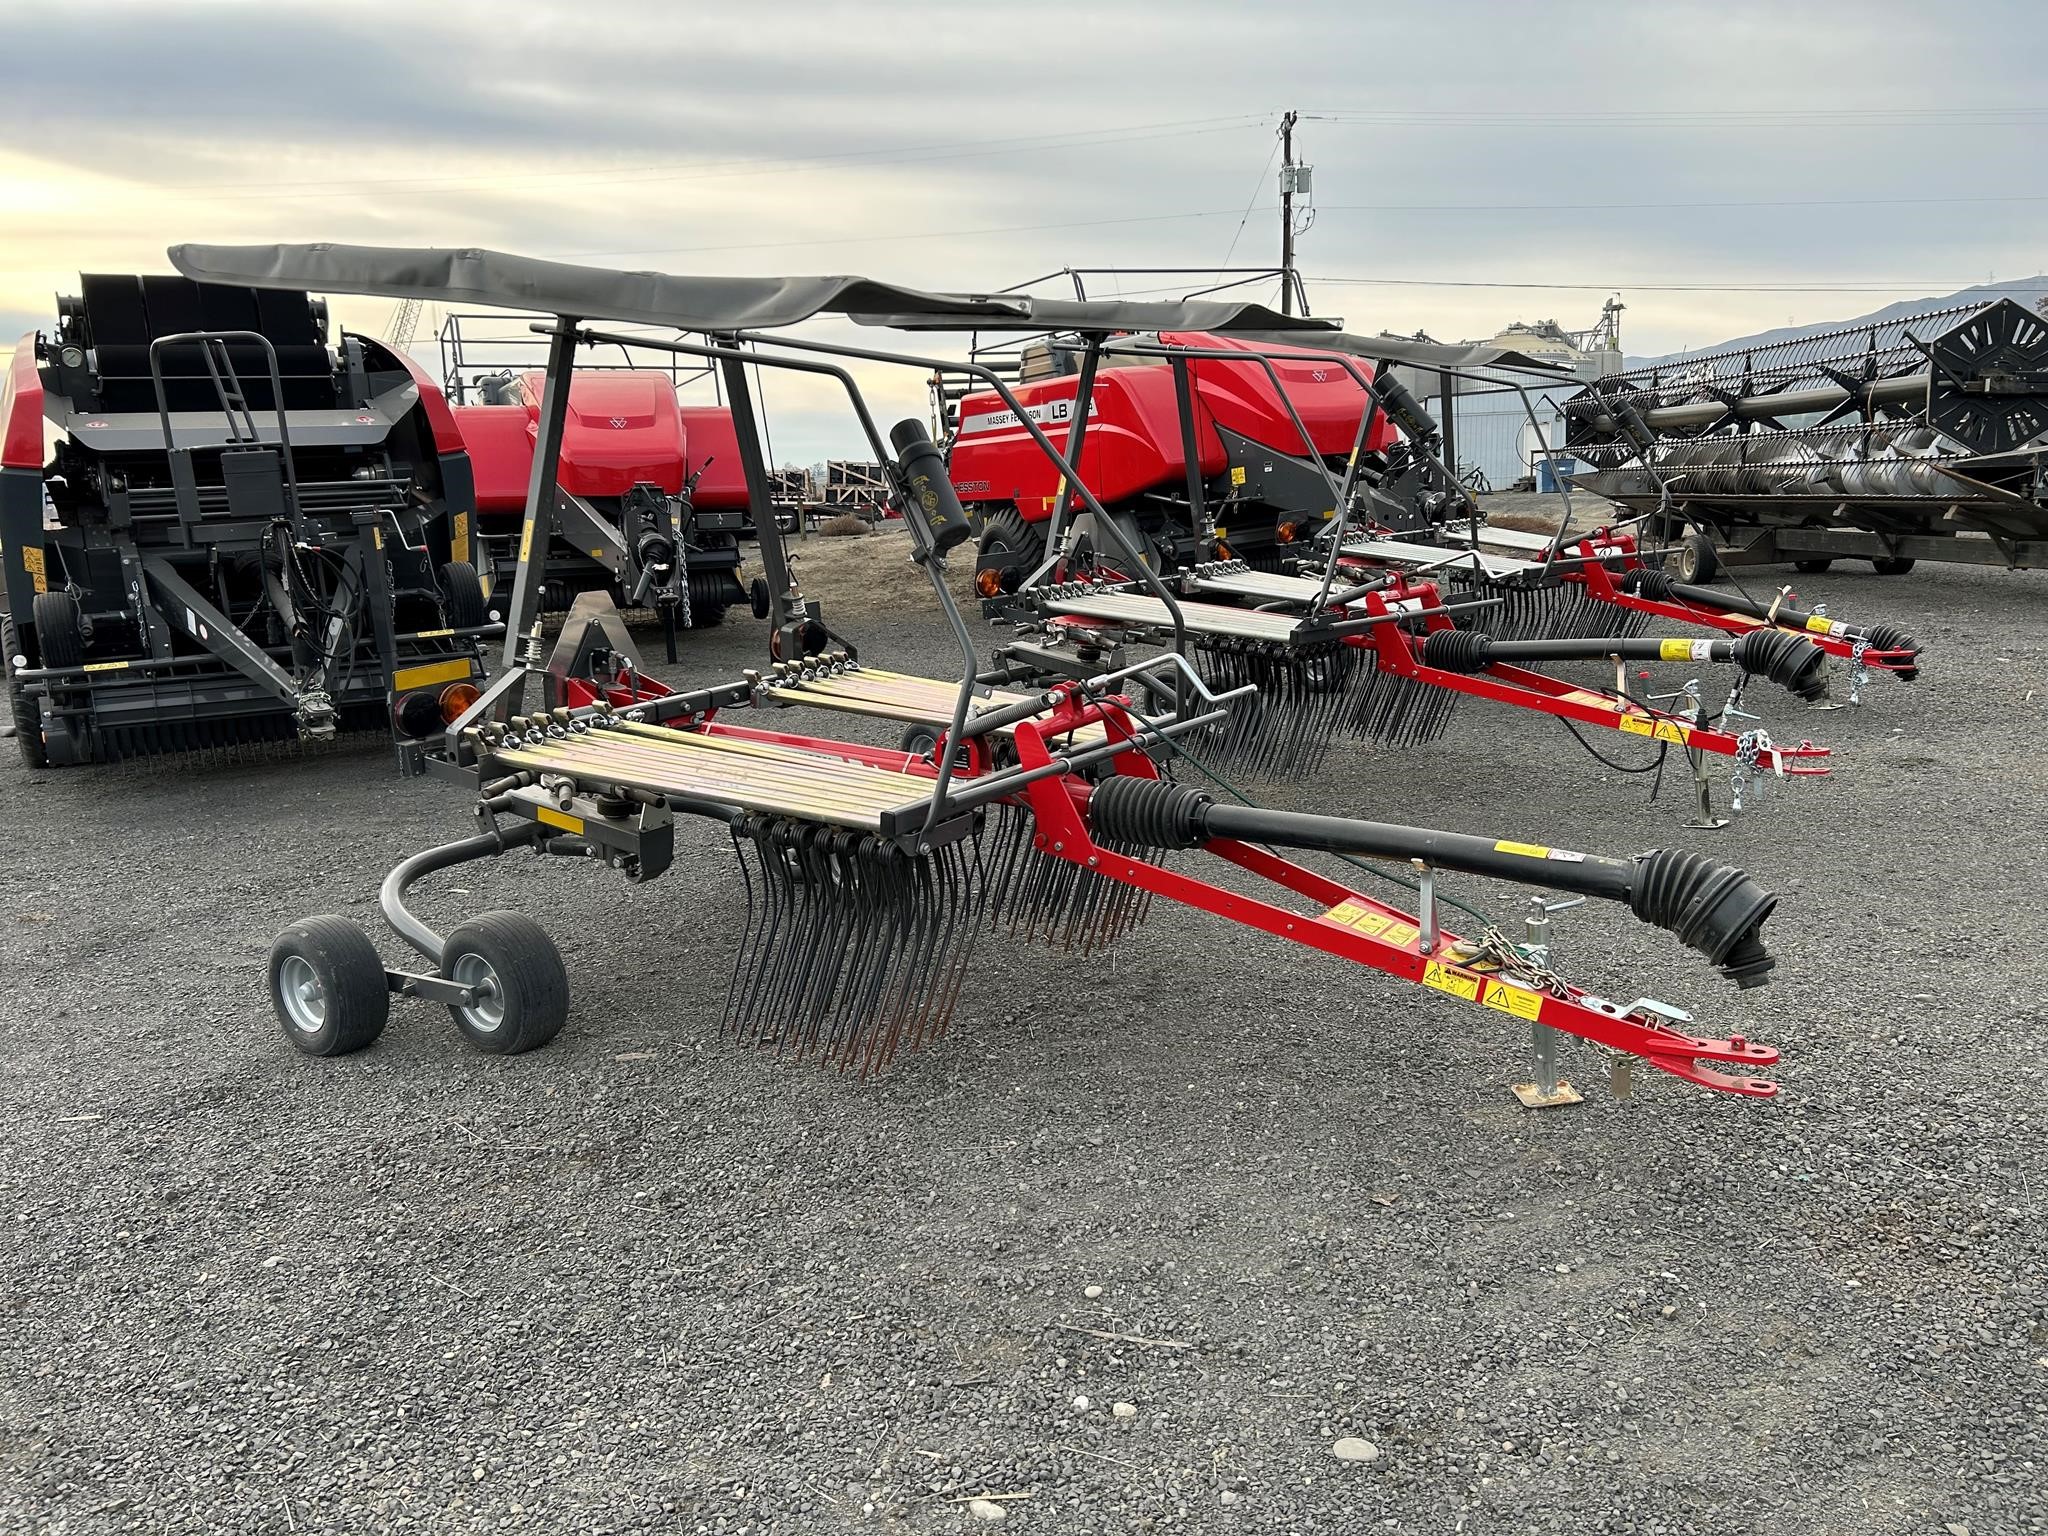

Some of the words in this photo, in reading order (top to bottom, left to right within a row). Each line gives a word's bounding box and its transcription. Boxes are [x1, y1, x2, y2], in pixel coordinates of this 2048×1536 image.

[987, 415, 1009, 425] MASSEY
[953, 481, 990, 492] HESSTON
[1451, 970, 1477, 983] WARNING
